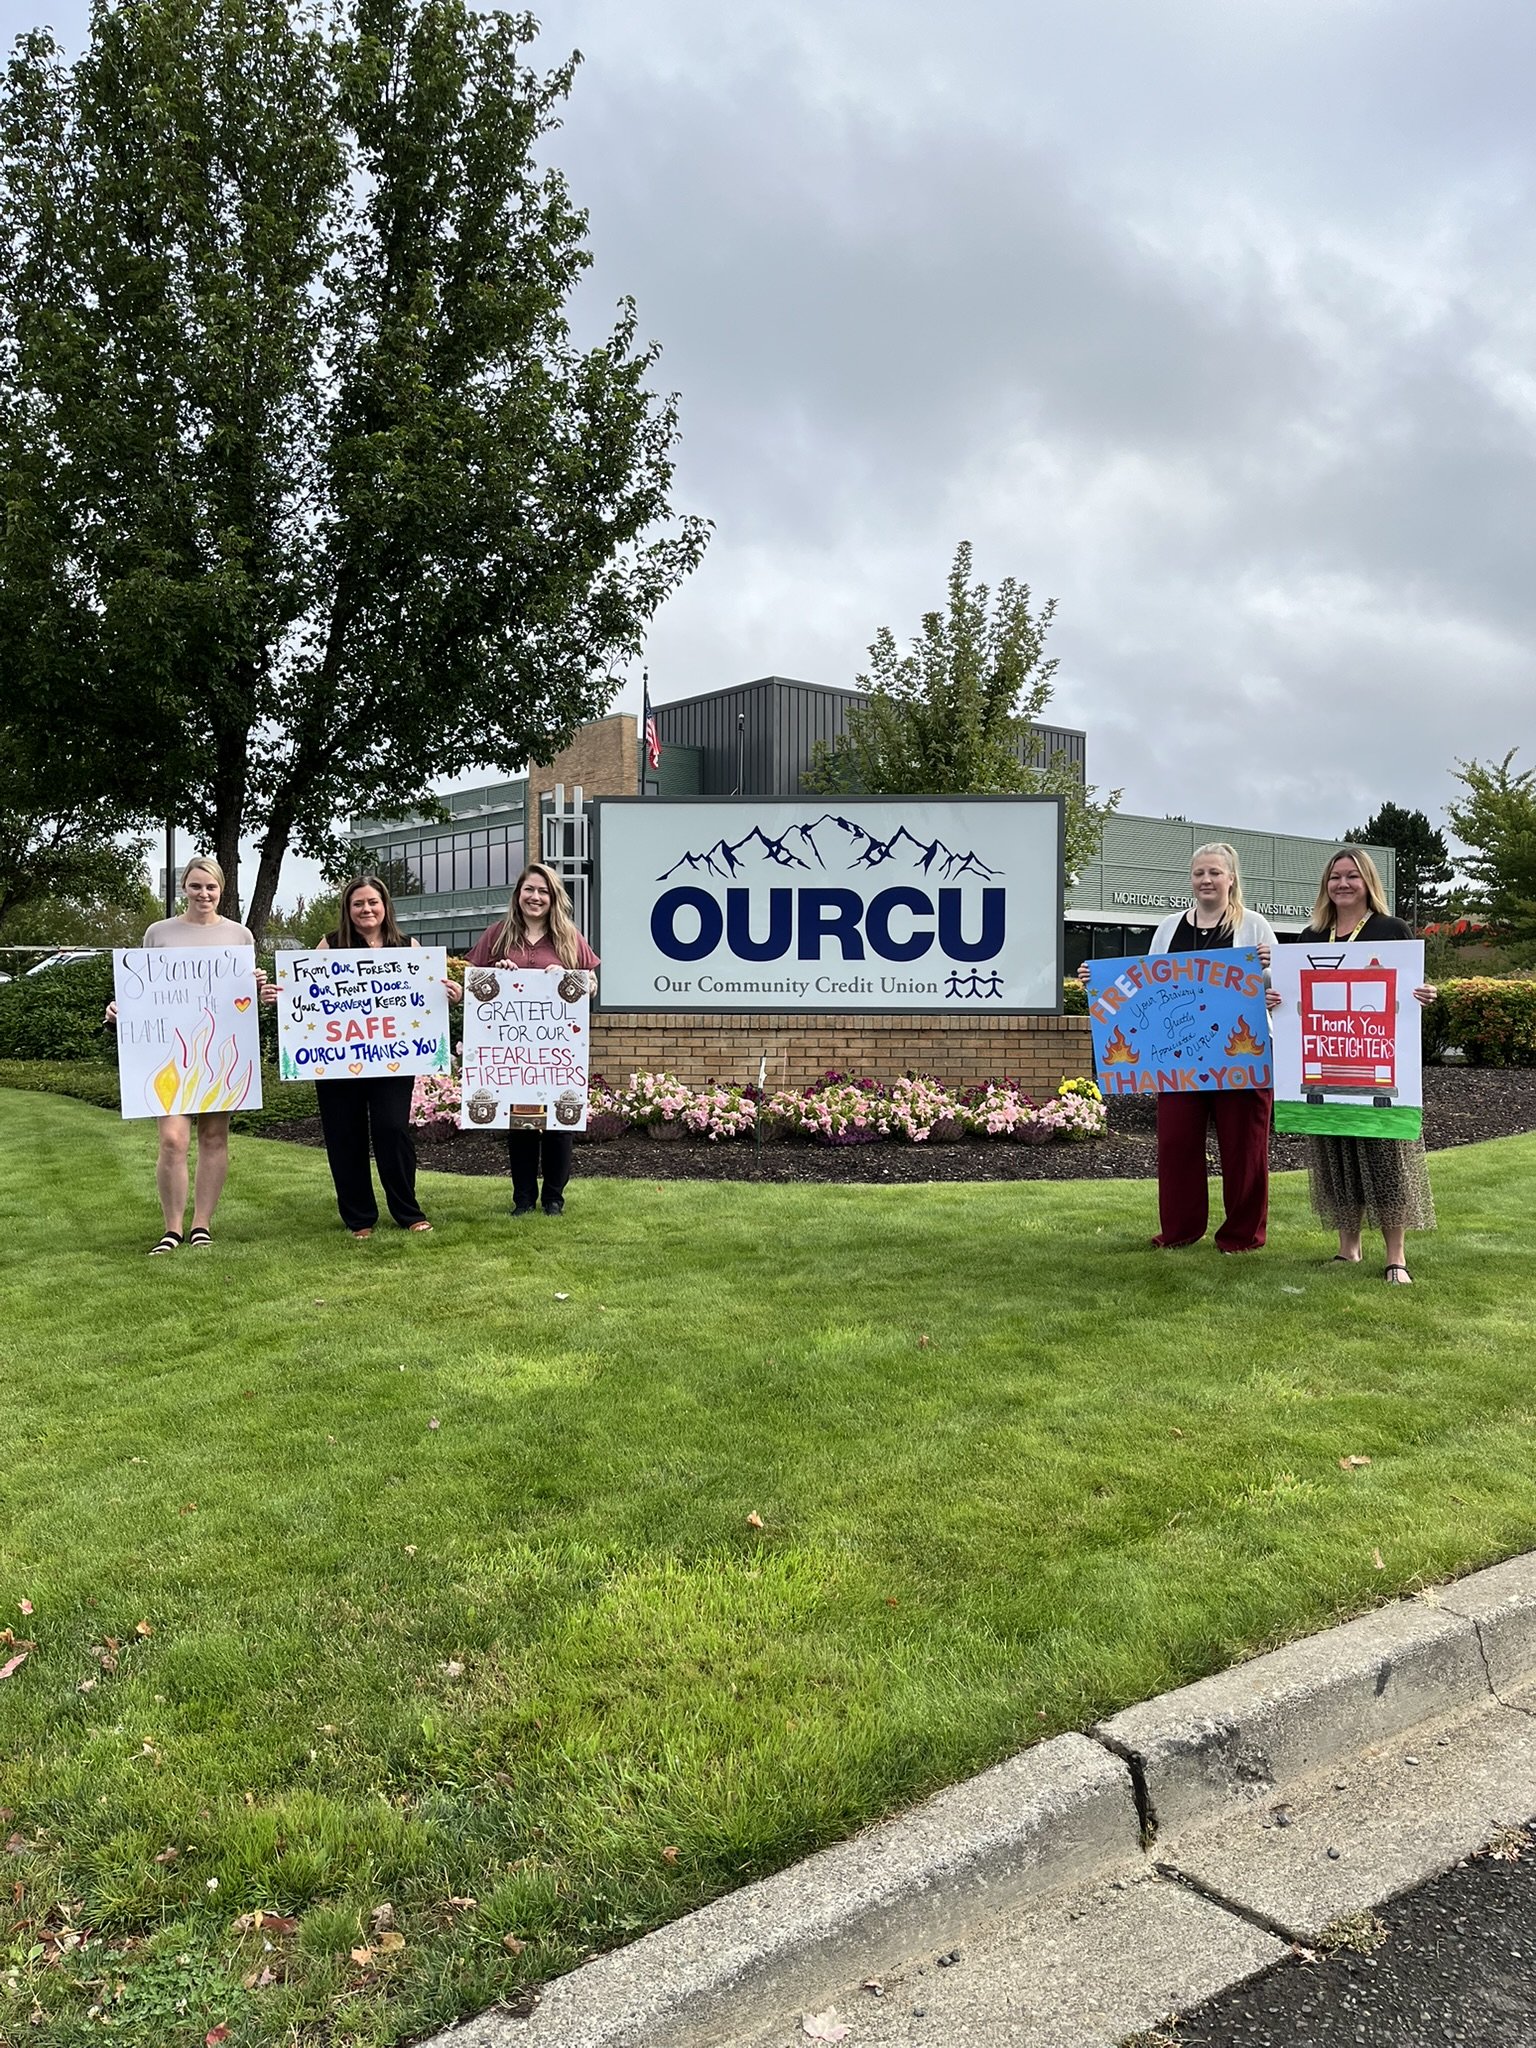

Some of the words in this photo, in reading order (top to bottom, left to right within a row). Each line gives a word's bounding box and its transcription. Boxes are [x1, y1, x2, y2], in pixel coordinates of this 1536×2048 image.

[1113, 892, 1165, 907] MORTGAGE
[1256, 903, 1303, 916] INVESTMENT
[650, 886, 1006, 962] OURCU
[123, 949, 246, 999] Stronger
[407, 962, 420, 976] to
[653, 976, 693, 993] Our
[698, 975, 810, 998] Community
[815, 975, 873, 994] Credit
[880, 975, 938, 994] Union
[1090, 958, 1264, 1025] FIREFIGHTERS
[152, 989, 189, 1005] THAN
[196, 995, 219, 1013] THE
[375, 996, 407, 1009] KEEPS
[476, 1001, 576, 1022] GRATEFUL
[1130, 996, 1156, 1031] Your
[1156, 987, 1197, 1013] Bravery
[120, 1017, 170, 1044] FLAME
[326, 1016, 397, 1042] SAFE
[499, 1025, 532, 1042] FOR
[536, 1025, 570, 1042] OUR
[1308, 1013, 1355, 1034] Thank
[1360, 1017, 1386, 1036] You
[295, 1045, 346, 1065] OURCU
[350, 1040, 409, 1063] THANKS
[412, 1037, 437, 1057] YOU
[478, 1046, 573, 1067] FEARLESS
[1304, 1035, 1395, 1059] FIREFIGHTERS
[465, 1065, 587, 1087] FIREFIGHTERS
[1099, 1067, 1199, 1094] THANK
[1209, 1065, 1272, 1091] YOU
